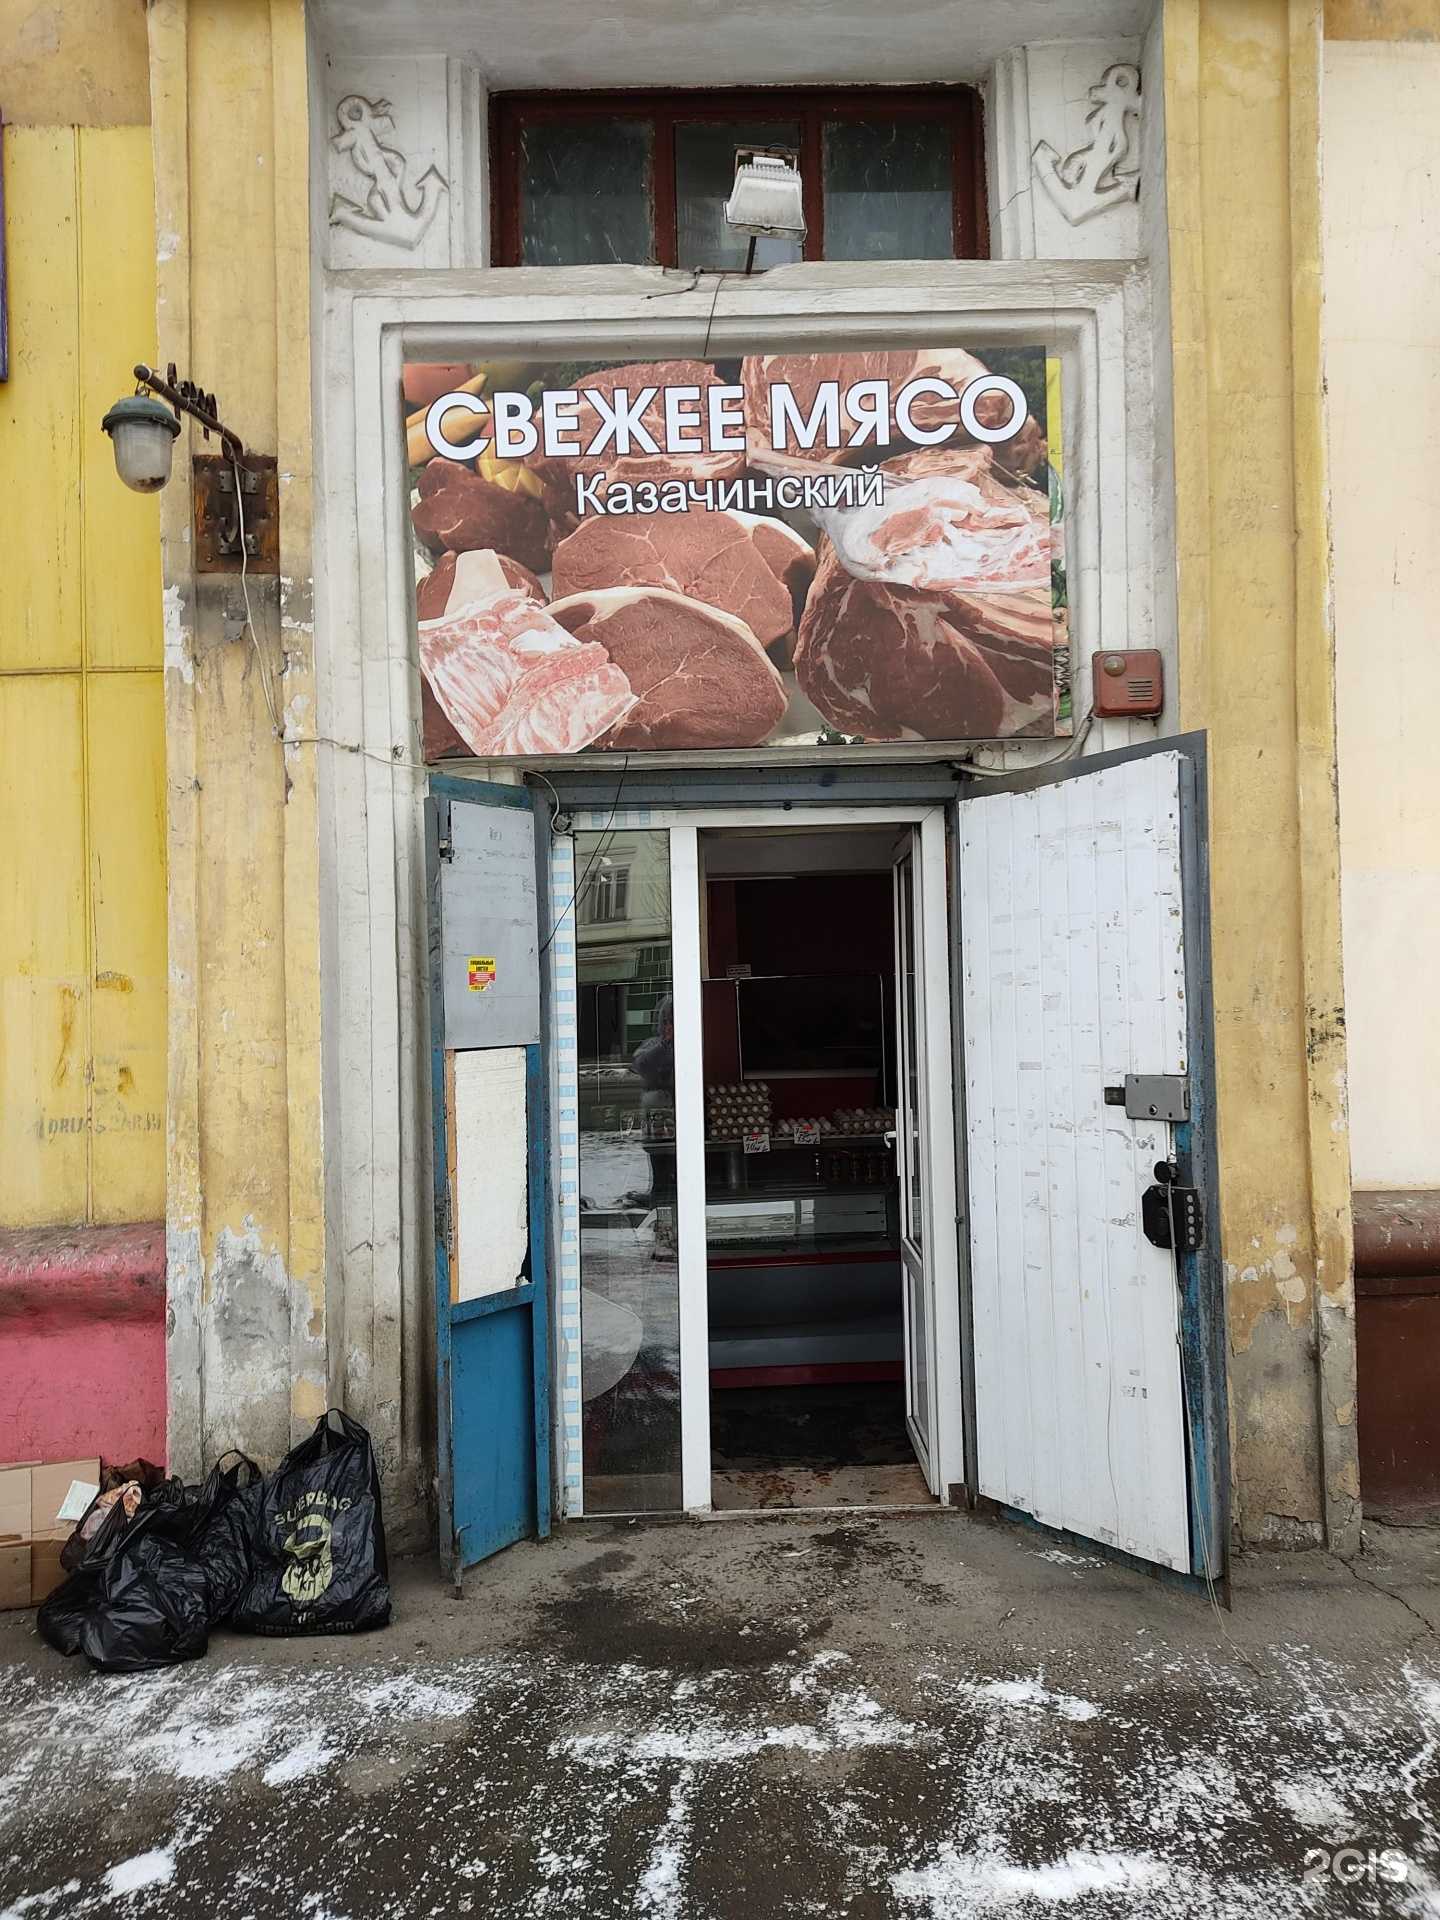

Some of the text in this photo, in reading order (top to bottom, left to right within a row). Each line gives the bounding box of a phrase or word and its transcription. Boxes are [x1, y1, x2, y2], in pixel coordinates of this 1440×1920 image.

[425, 374, 1028, 460] СВЕЖЕЕ МЯСО
[576, 464, 884, 515] Казачинский
[273, 1490, 352, 1526] SUERBAG
